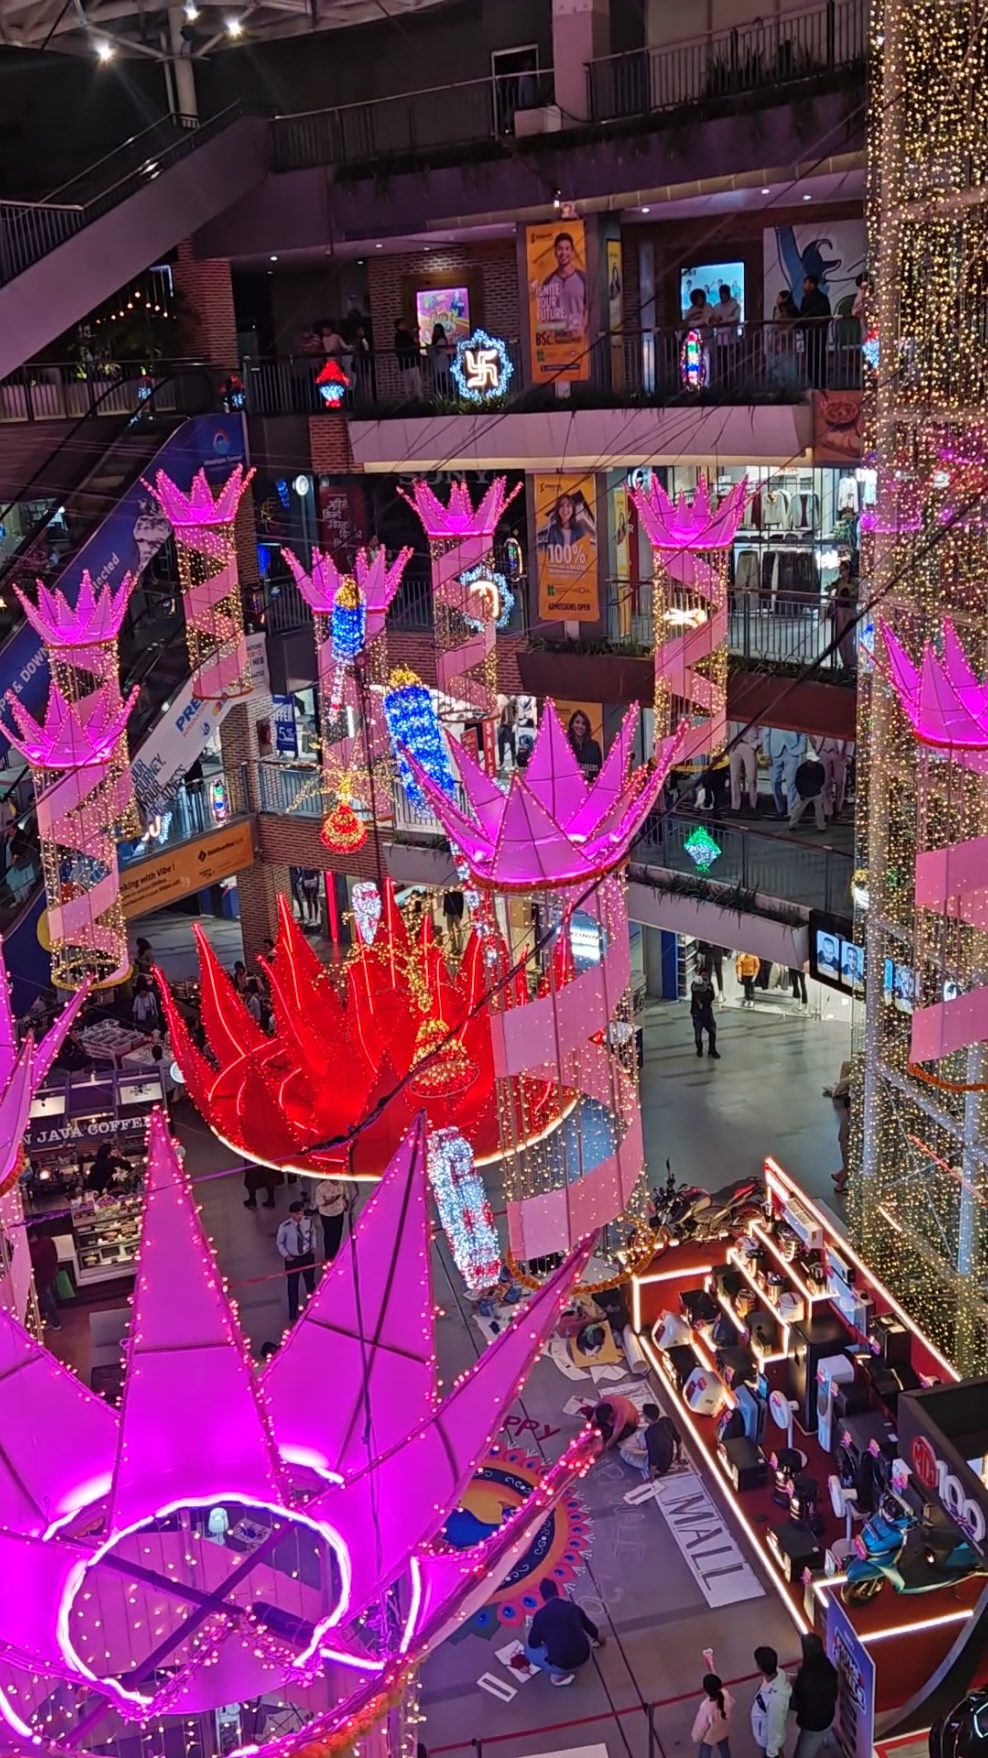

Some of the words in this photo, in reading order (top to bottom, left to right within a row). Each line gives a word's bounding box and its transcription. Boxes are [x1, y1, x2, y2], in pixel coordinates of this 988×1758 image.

[536, 283, 560, 297] IGNITE
[537, 296, 558, 309] YOUR
[547, 543, 586, 564] 100%
[548, 602, 577, 611] ADMISSIONS
[577, 602, 591, 611] OPEN
[12, 681, 24, 693] &
[485, 722, 494, 778] SALE
[140, 870, 156, 884] with
[156, 865, 172, 877] Vibe
[36, 1125, 84, 1144] JAVA
[664, 1493, 745, 1592] MALL
